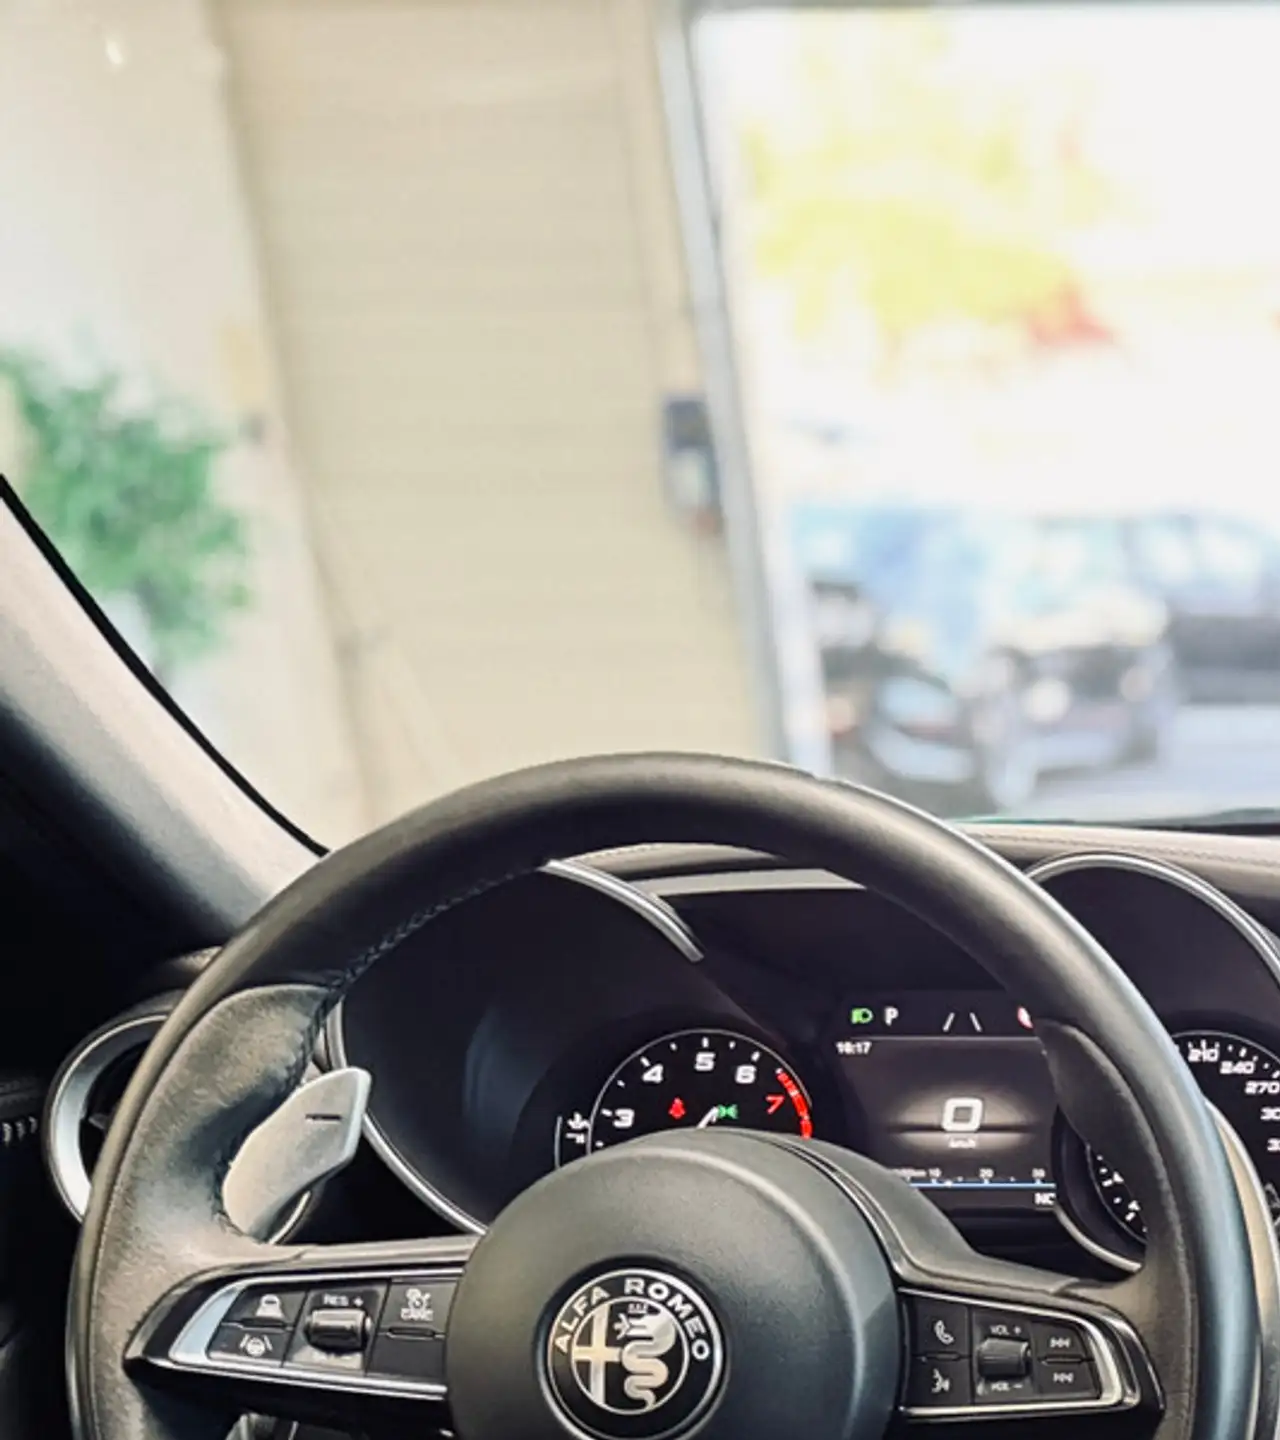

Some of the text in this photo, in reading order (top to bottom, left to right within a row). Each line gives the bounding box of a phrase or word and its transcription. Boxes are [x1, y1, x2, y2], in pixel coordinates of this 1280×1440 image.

[884, 1007, 899, 1026] P
[694, 1052, 716, 1071] 5
[1219, 1060, 1255, 1075] 240
[642, 1064, 664, 1084] 4
[735, 1064, 756, 1084] 6
[1244, 1081, 1280, 1094] 270
[765, 1095, 785, 1114] 7
[612, 1108, 635, 1128] 3
[941, 1097, 984, 1133] 0
[554, 1277, 712, 1361] ALFA ROMEO
[990, 1324, 1010, 1336] VOL
[990, 1381, 1011, 1392] VOL
